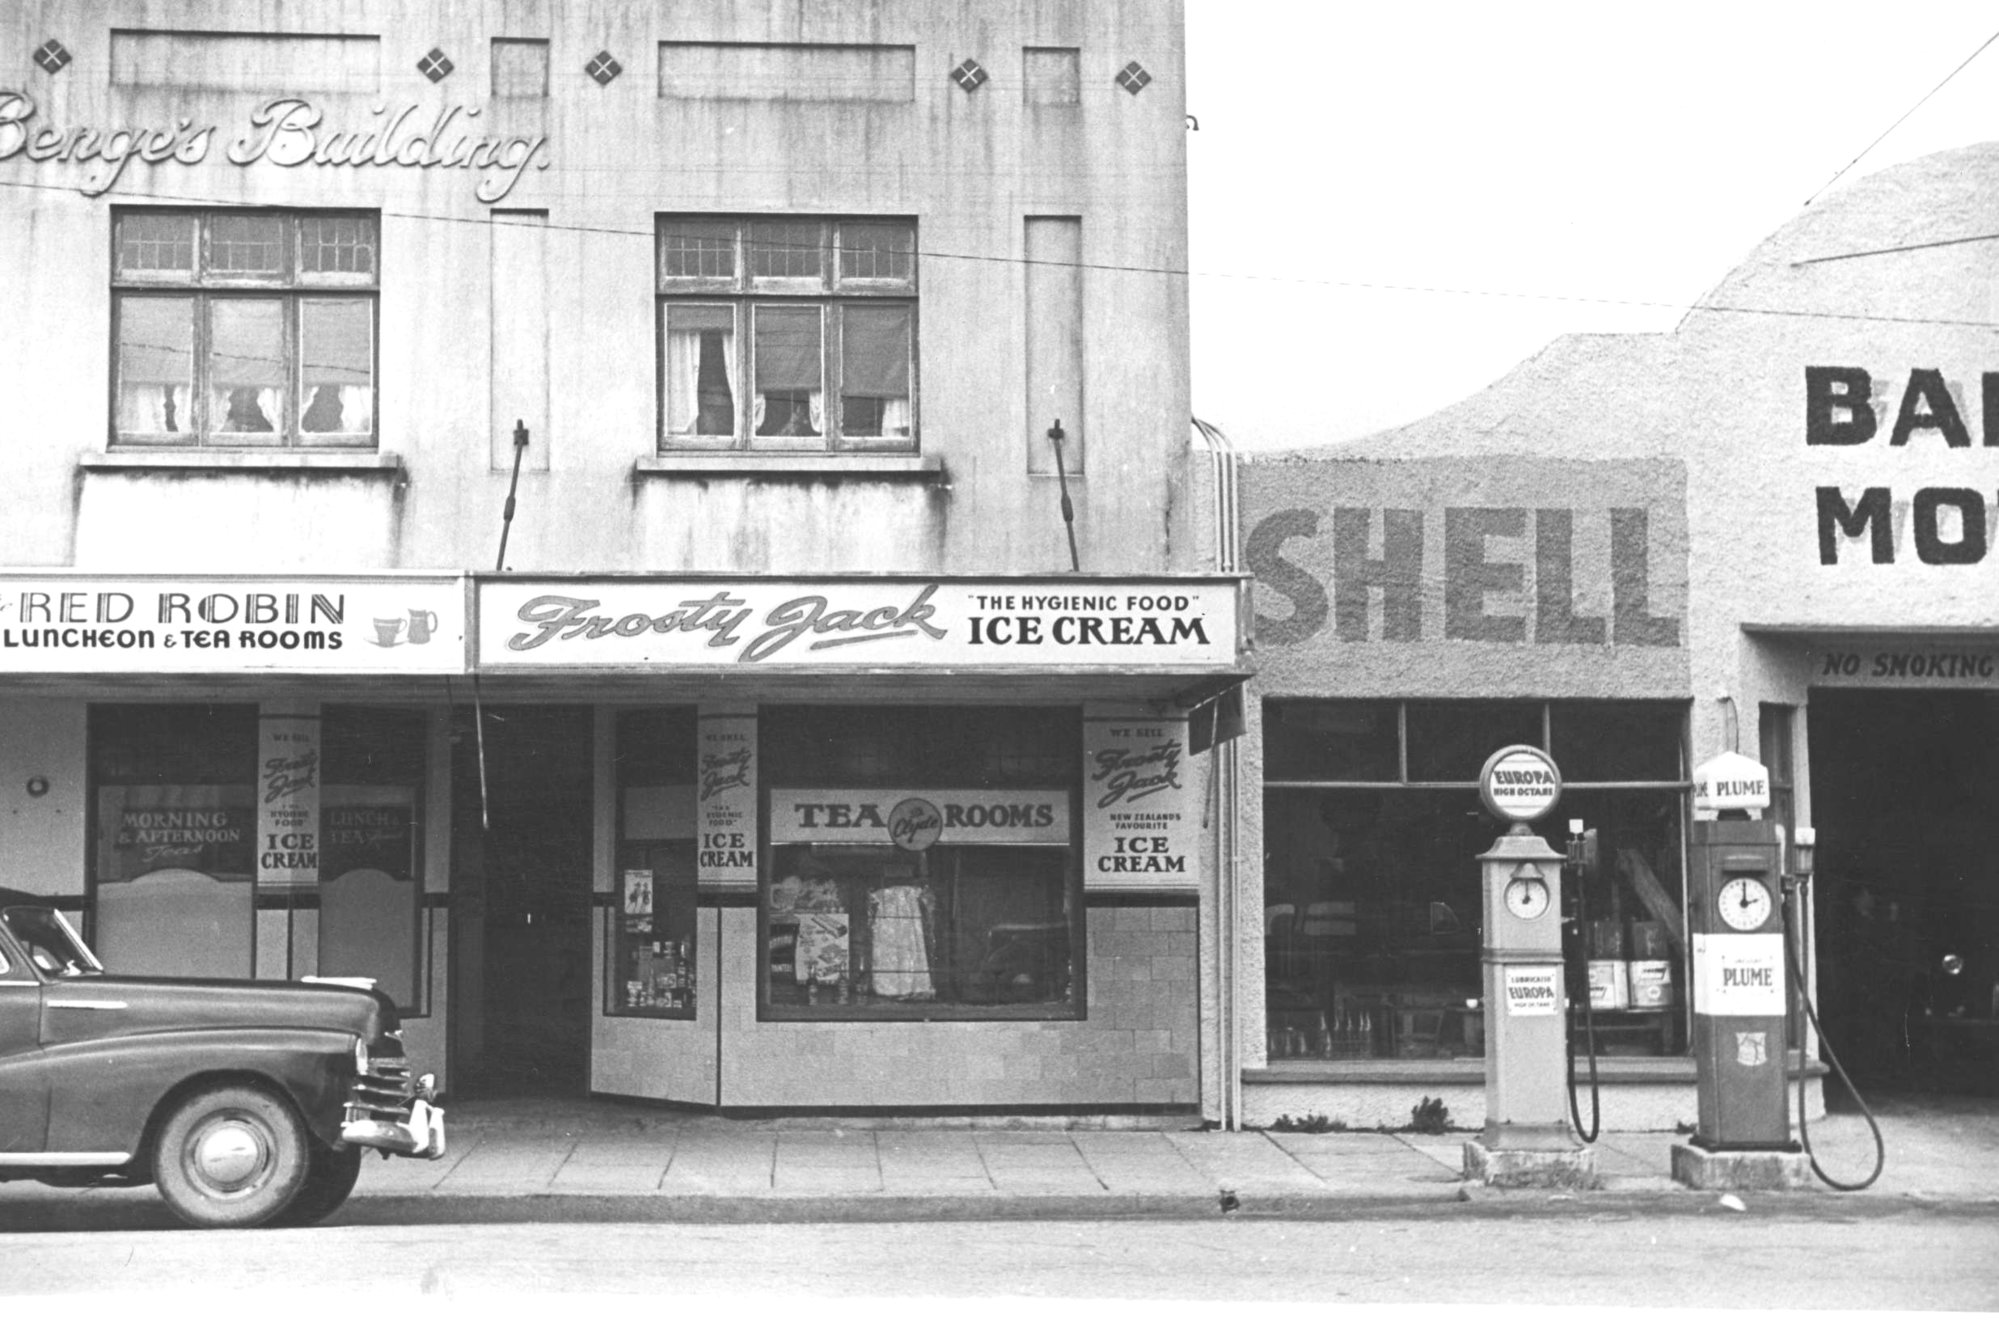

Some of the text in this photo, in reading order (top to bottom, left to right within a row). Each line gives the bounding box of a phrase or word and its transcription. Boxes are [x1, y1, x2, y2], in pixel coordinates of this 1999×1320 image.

[0, 91, 216, 198] Benge's
[1816, 486, 1999, 566] MO
[1245, 507, 1681, 647] SHELL
[19, 592, 134, 623] RED
[158, 593, 345, 624] ROBIN
[1022, 595, 1118, 611] HYGIENIC
[508, 584, 949, 663] Frosty Jack
[967, 616, 1211, 645] ICE CREAM
[164, 633, 177, 649] &
[181, 629, 230, 649] TEA
[239, 630, 344, 649] ROOMS
[1822, 652, 1995, 679] NO SMOKING
[1091, 739, 1182, 781] Frosty
[1494, 770, 1555, 785] EUROPA
[1097, 768, 1182, 809] Jack
[1494, 787, 1553, 796] HIGH OCTANE
[1716, 780, 1765, 797] PLUME
[121, 811, 228, 828] MORNING
[794, 803, 889, 828] TEA
[943, 803, 1055, 828] ROOMS
[1110, 813, 1132, 822] NEW
[1115, 822, 1169, 830] FAVOURITE
[136, 828, 240, 844] AFTERNOON
[267, 833, 314, 850] ICE
[703, 833, 745, 849] ICE
[1114, 836, 1169, 853] ICE
[261, 852, 317, 869] CREAM
[700, 850, 753, 867] CREAM
[1098, 855, 1186, 873] CREAM
[1723, 967, 1773, 987] PLUME
[1508, 986, 1554, 999] EUROPA
